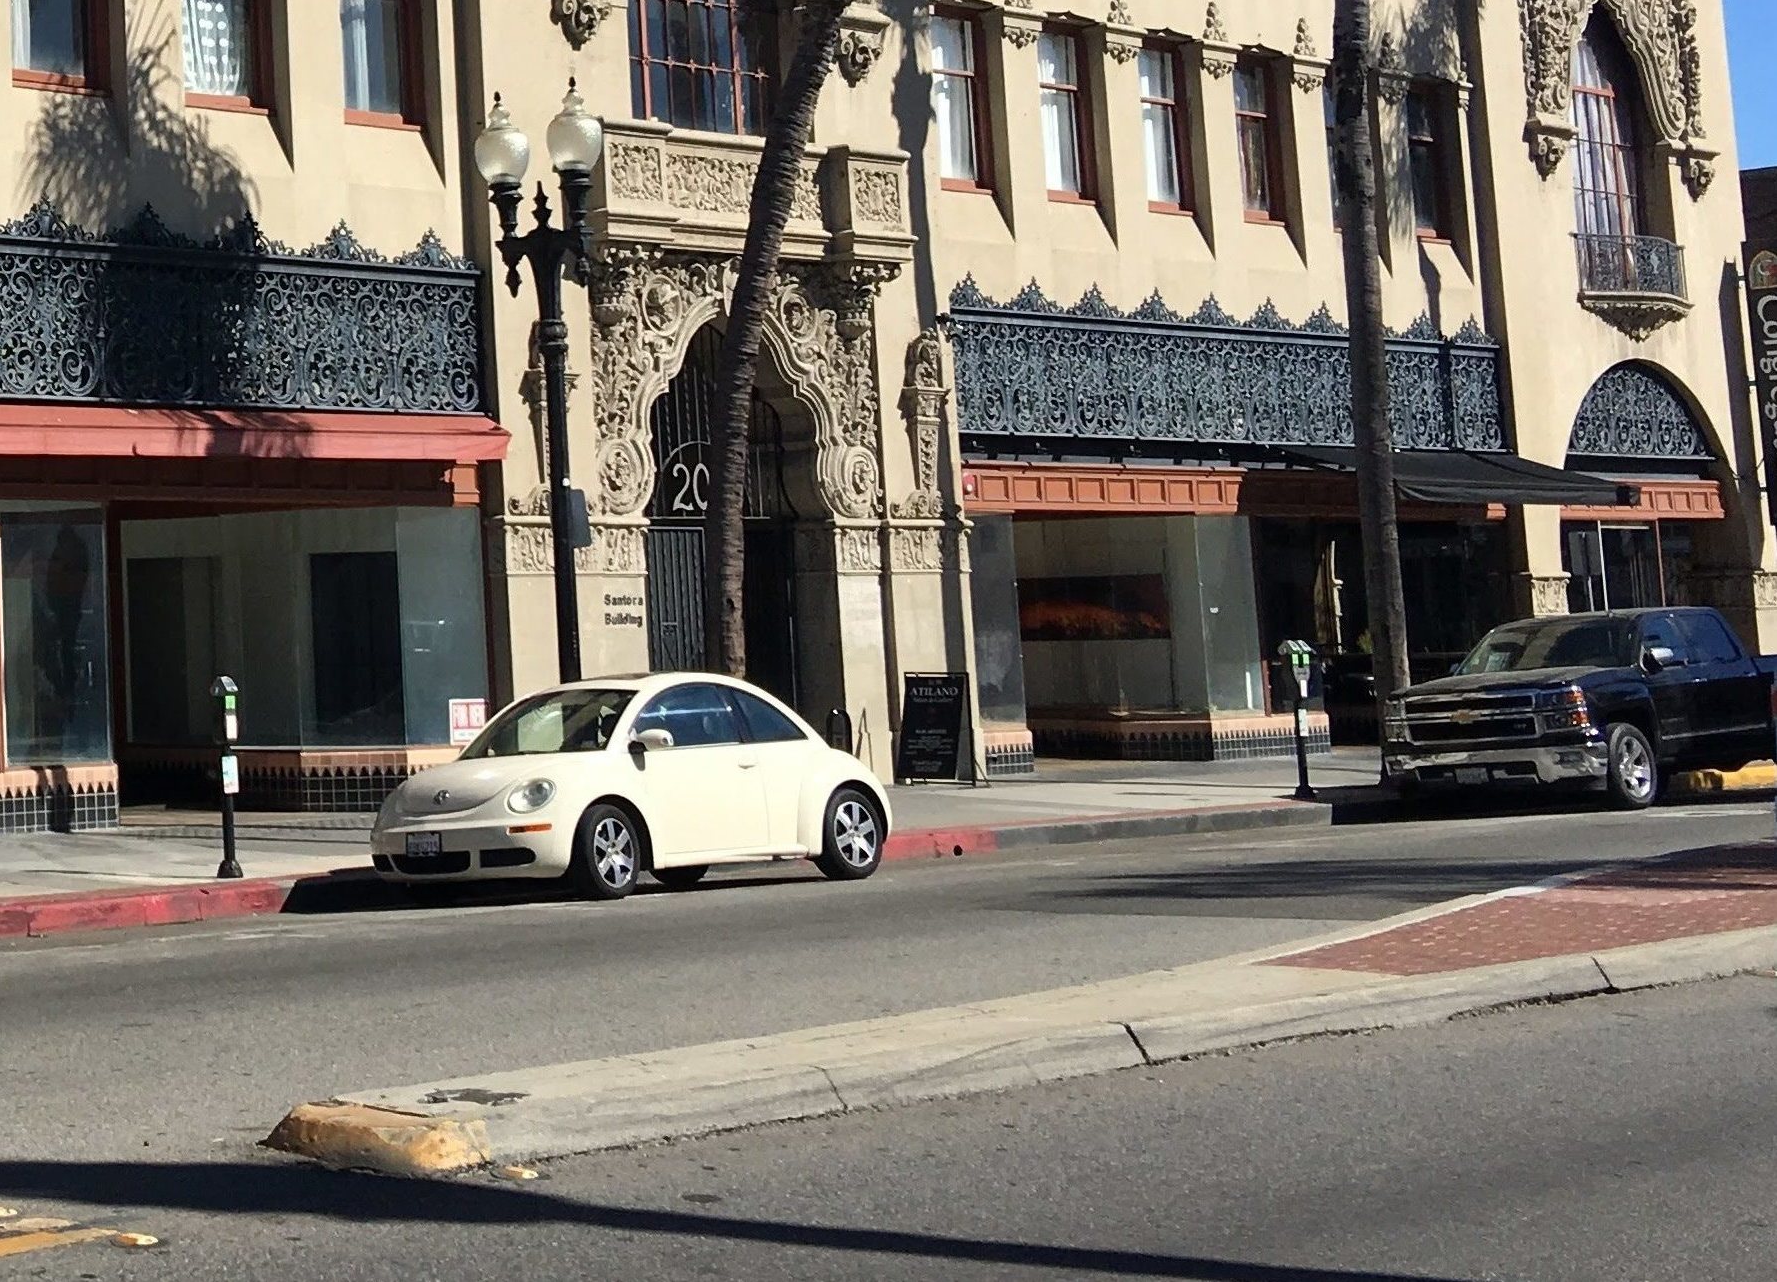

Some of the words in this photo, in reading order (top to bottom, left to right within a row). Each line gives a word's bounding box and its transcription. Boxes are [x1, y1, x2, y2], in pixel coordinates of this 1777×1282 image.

[604, 594, 643, 606] Santora
[604, 613, 643, 628] Building
[909, 687, 959, 697] ATILANO
